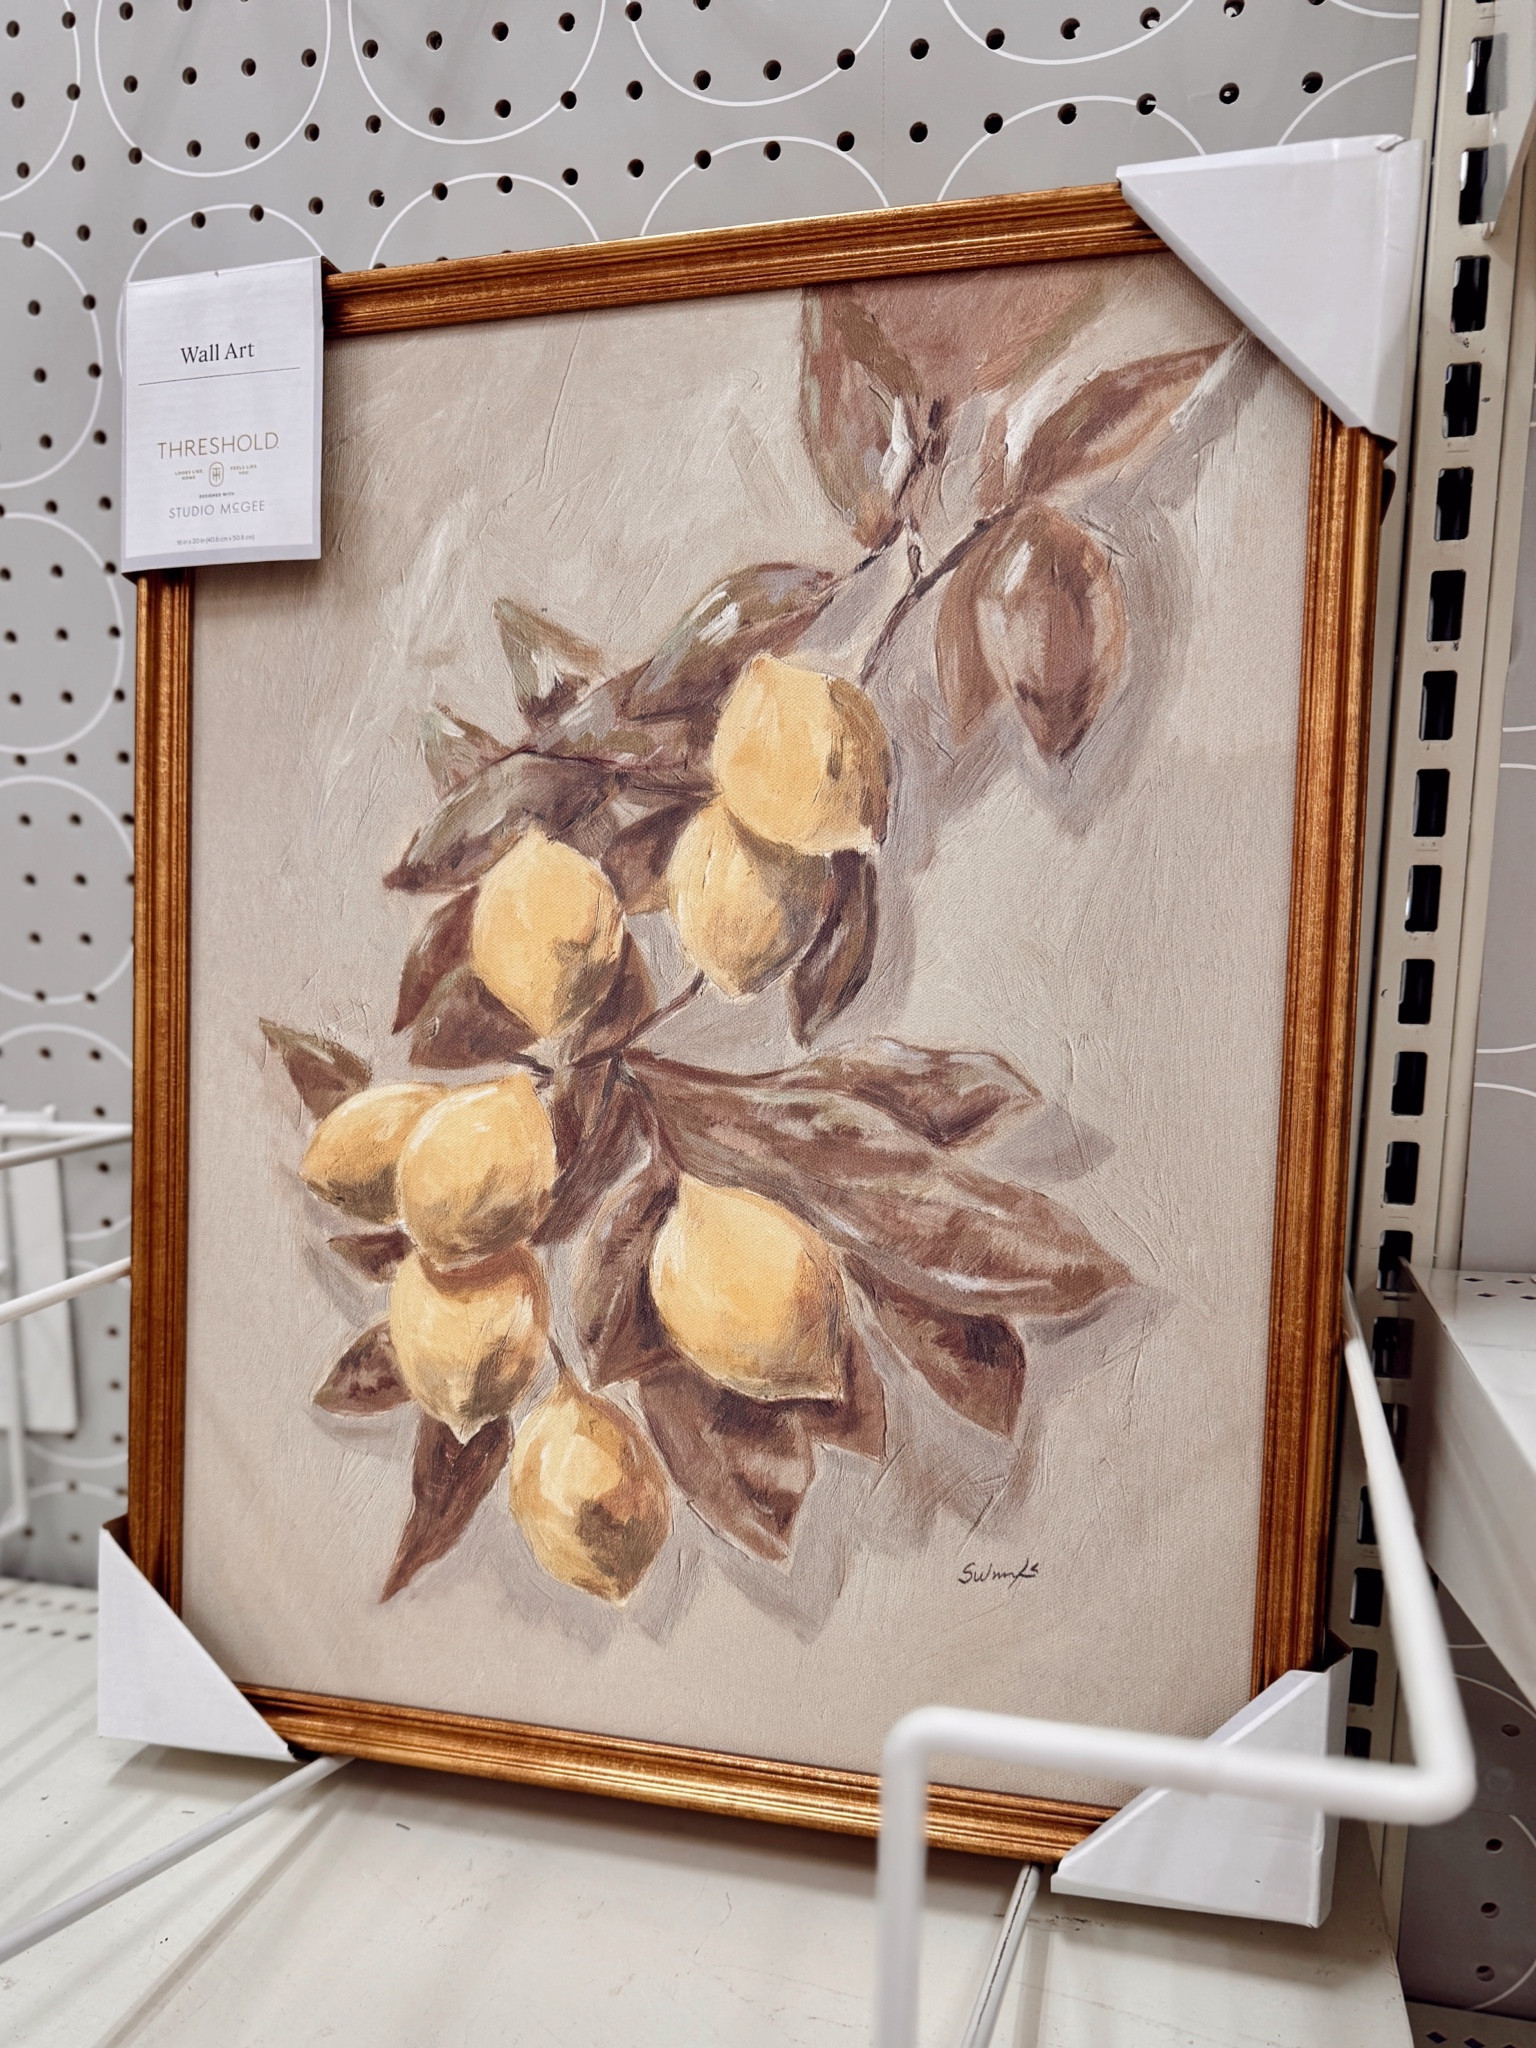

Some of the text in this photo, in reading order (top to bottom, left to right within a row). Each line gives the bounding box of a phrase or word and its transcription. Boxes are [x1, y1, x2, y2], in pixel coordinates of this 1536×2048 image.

[180, 342, 255, 364] Wall Art
[157, 432, 279, 459] THRESHOLD
[168, 504, 215, 519] STUDIO
